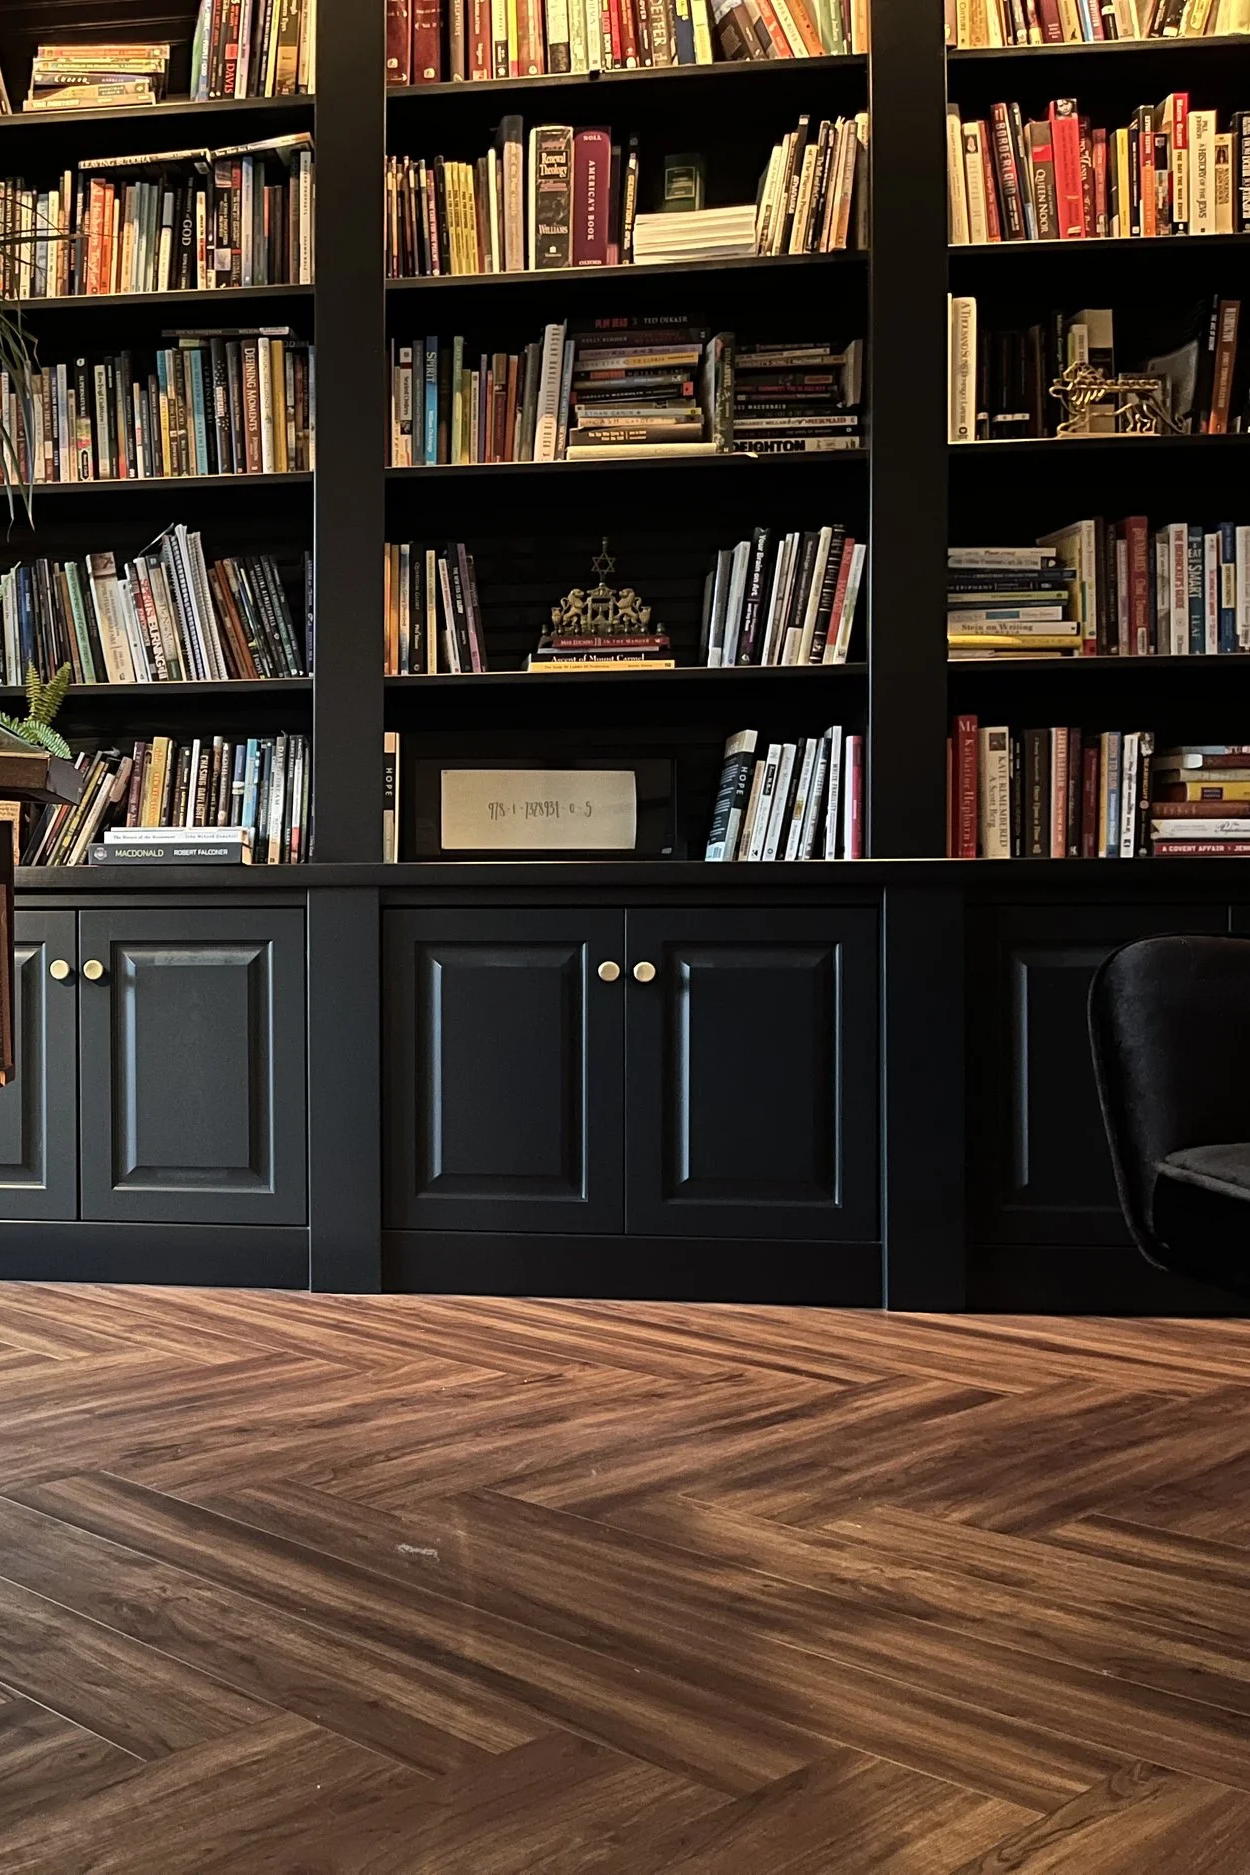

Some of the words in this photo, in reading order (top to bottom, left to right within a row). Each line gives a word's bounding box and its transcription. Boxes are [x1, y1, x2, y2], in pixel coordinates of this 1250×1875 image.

[225, 62, 237, 94] DAVIS
[1176, 99, 1184, 122] MARTIN
[1176, 123, 1185, 148] GILBERT
[82, 157, 116, 168] LEAVING
[117, 154, 152, 165] BUDDHA
[541, 152, 567, 163] Renewal
[995, 122, 1017, 196] BORDERLAND
[1176, 151, 1184, 162] THE
[1197, 148, 1208, 179] HISTORY
[540, 164, 568, 178] Theology
[587, 160, 598, 212] AMERICA'S
[625, 174, 636, 224] GENERATION
[1035, 169, 1048, 203] QUEEN
[1037, 203, 1050, 234] NOOR
[1196, 200, 1208, 219] JEWS
[181, 220, 193, 246] GOD
[586, 214, 597, 241] BOOK
[659, 316, 688, 324] DEKKER
[961, 310, 971, 350] THOUSAND
[244, 348, 258, 388] DEFINING
[426, 351, 437, 384] SPIRIT
[77, 375, 87, 419] SUPERNATURAL
[97, 371, 105, 397] Revival
[98, 397, 108, 423] Culture
[246, 389, 259, 432] MOMENTS
[733, 440, 806, 453] DEIGHTON
[757, 534, 768, 551] Your
[754, 551, 765, 572] Brain
[751, 584, 761, 597] Art
[753, 572, 760, 583] on
[1188, 564, 1202, 599] SMART
[1175, 589, 1186, 610] GUIDE
[999, 623, 1034, 633] Writing
[149, 621, 166, 664] BURNING
[284, 643, 293, 661] SILK
[616, 653, 645, 661] Carmel
[276, 746, 285, 766] DARE
[998, 755, 1008, 781] KATE
[198, 755, 209, 786] CHASING
[386, 767, 394, 797] HOPE
[736, 766, 749, 796] HOPE
[195, 787, 207, 820] DAYLIGHT
[989, 783, 998, 807] Scott
[961, 791, 977, 840] Hepburn
[987, 808, 998, 829] Berg
[998, 782, 1009, 848] REMEMBERED
[115, 849, 164, 858] MACDONALD
[198, 848, 229, 856] FALCONER
